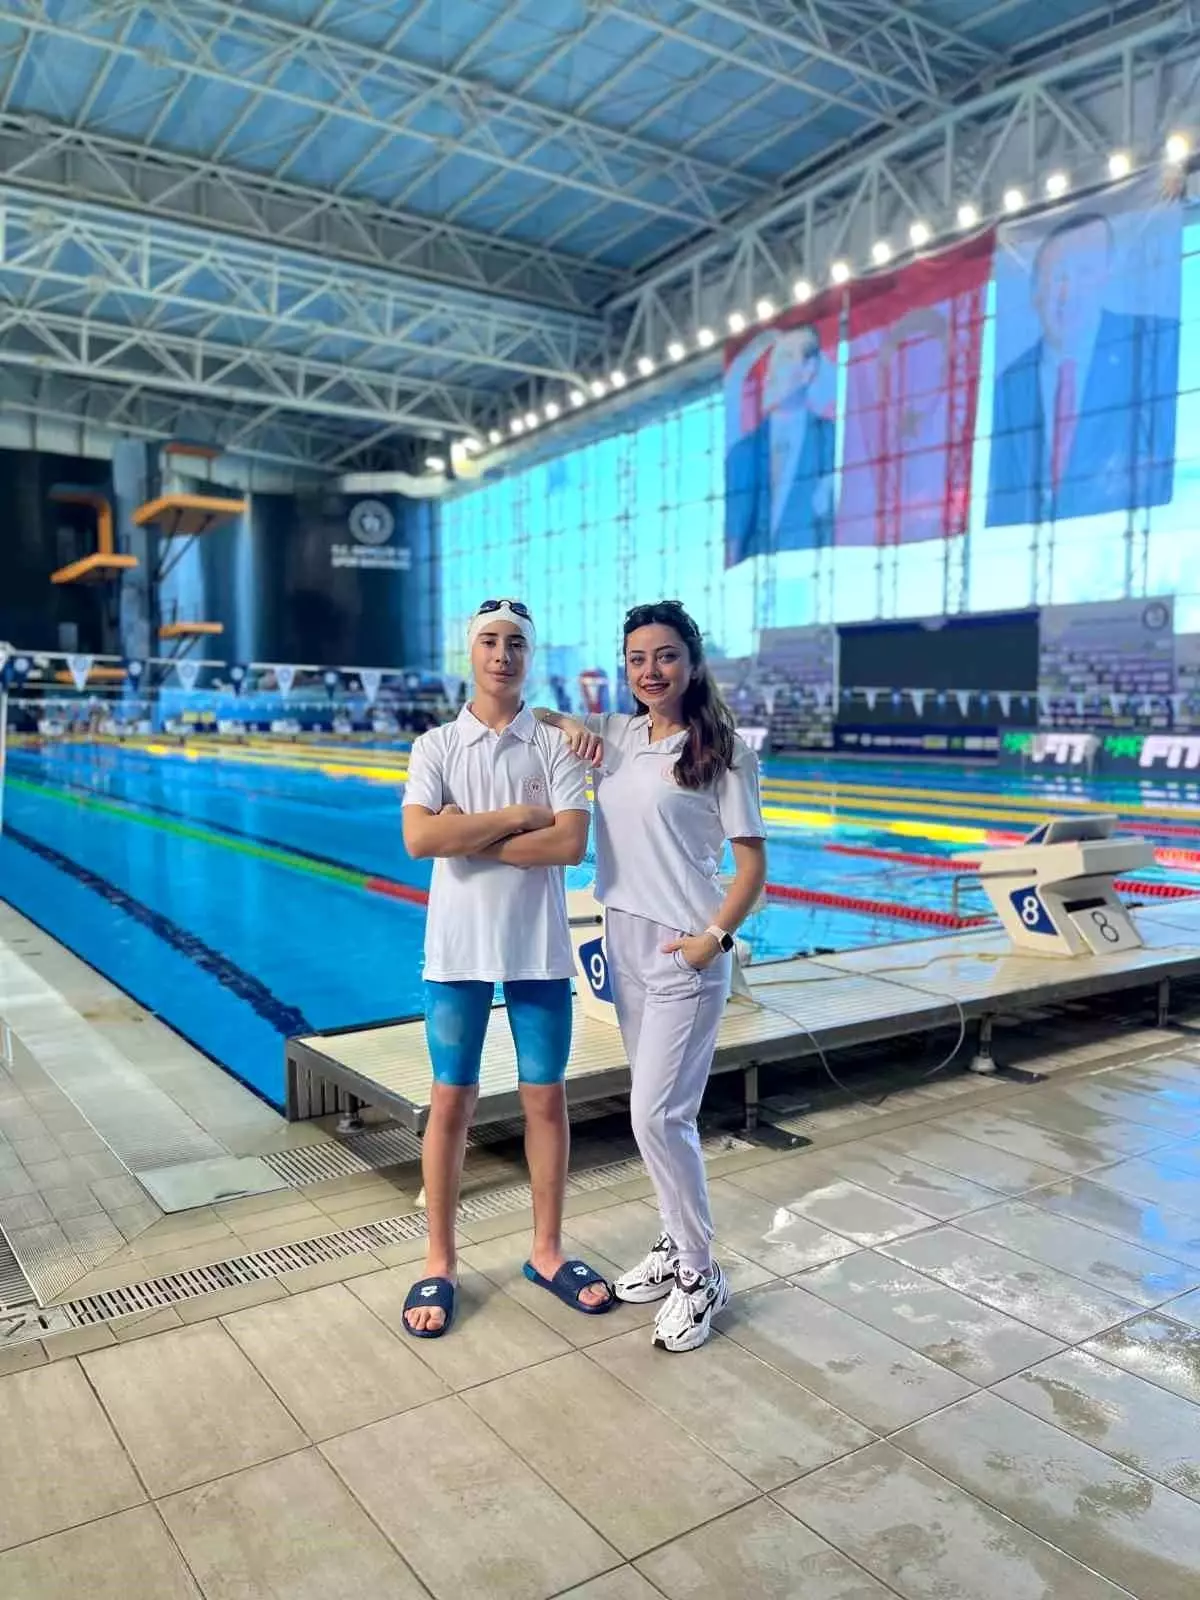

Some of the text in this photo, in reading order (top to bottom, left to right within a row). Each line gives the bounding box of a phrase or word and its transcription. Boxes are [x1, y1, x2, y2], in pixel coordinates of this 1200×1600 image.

[1022, 896, 1039, 925] 8
[1091, 911, 1120, 943] 8
[591, 954, 605, 990] 9
